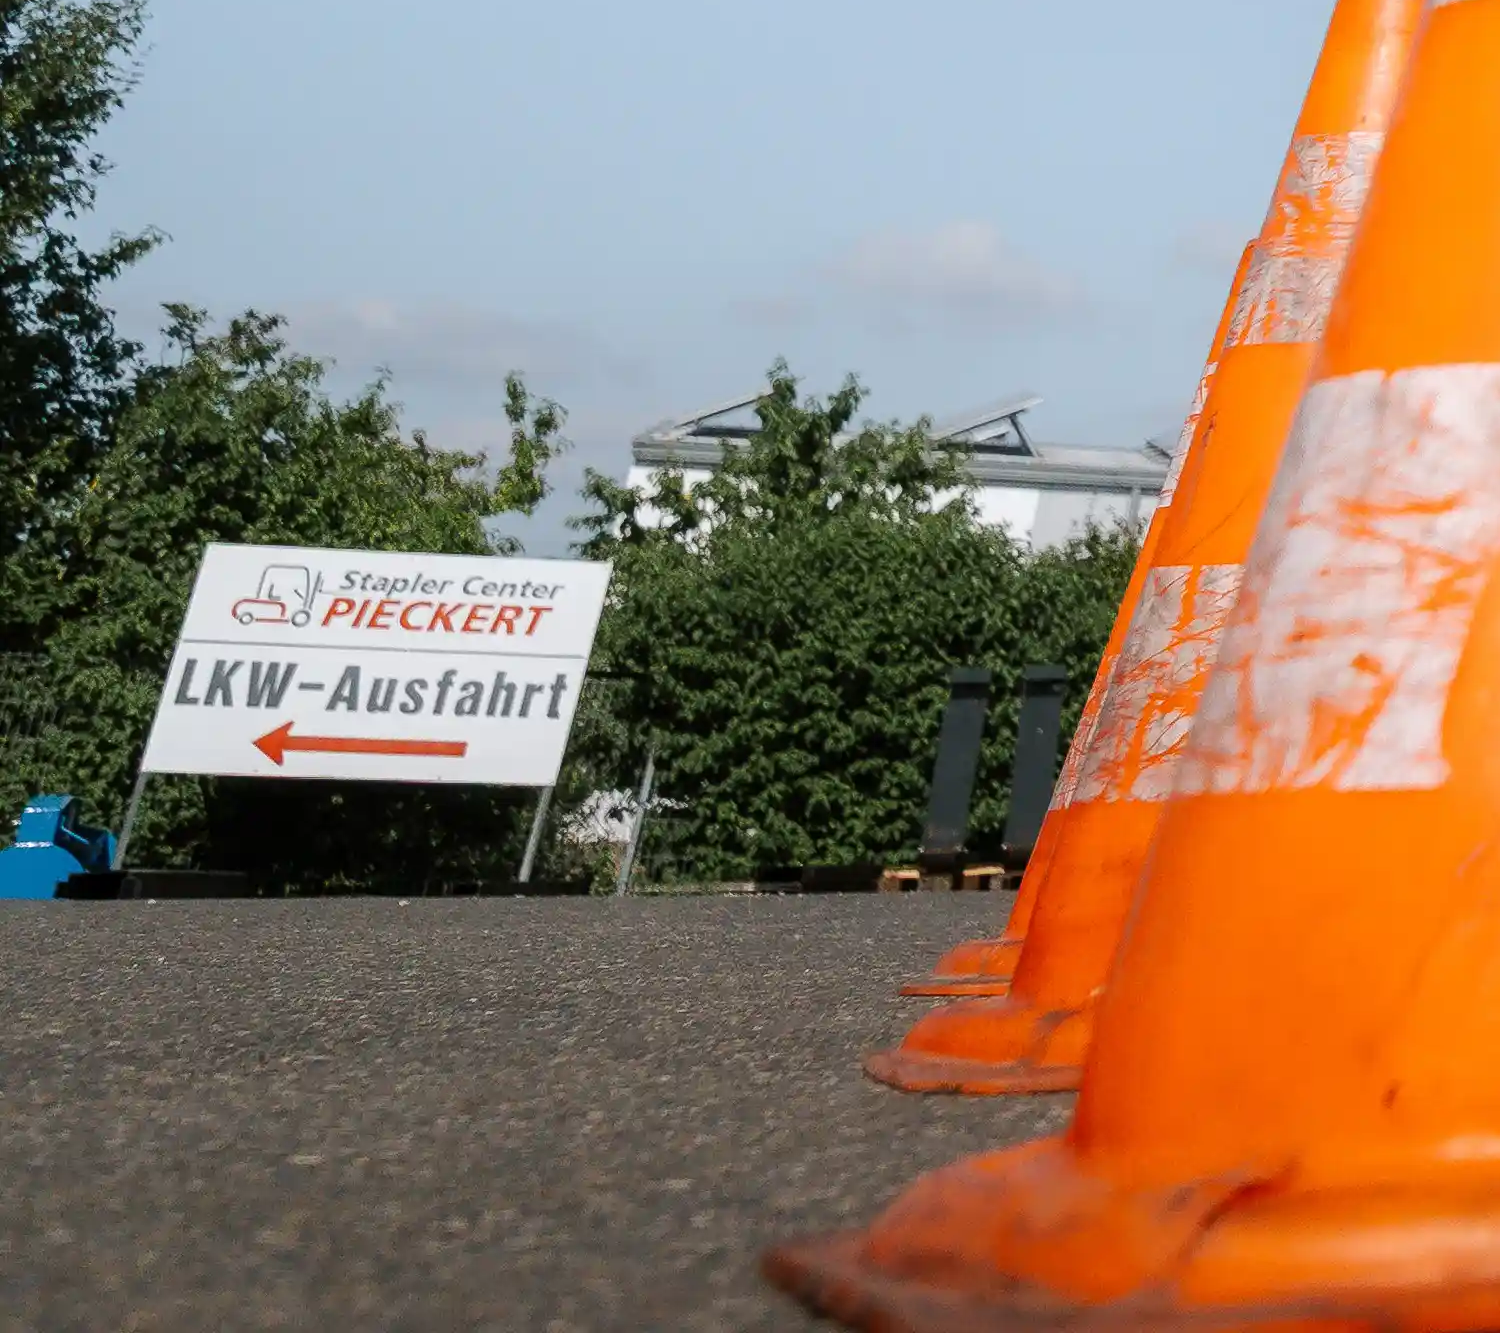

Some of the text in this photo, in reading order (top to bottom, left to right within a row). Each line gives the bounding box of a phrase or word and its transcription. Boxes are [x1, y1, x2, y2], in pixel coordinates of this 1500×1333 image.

[339, 570, 565, 601] Stapler Center
[321, 598, 554, 635] PIECKERT
[174, 658, 568, 720] LKW-Ausfahrt
